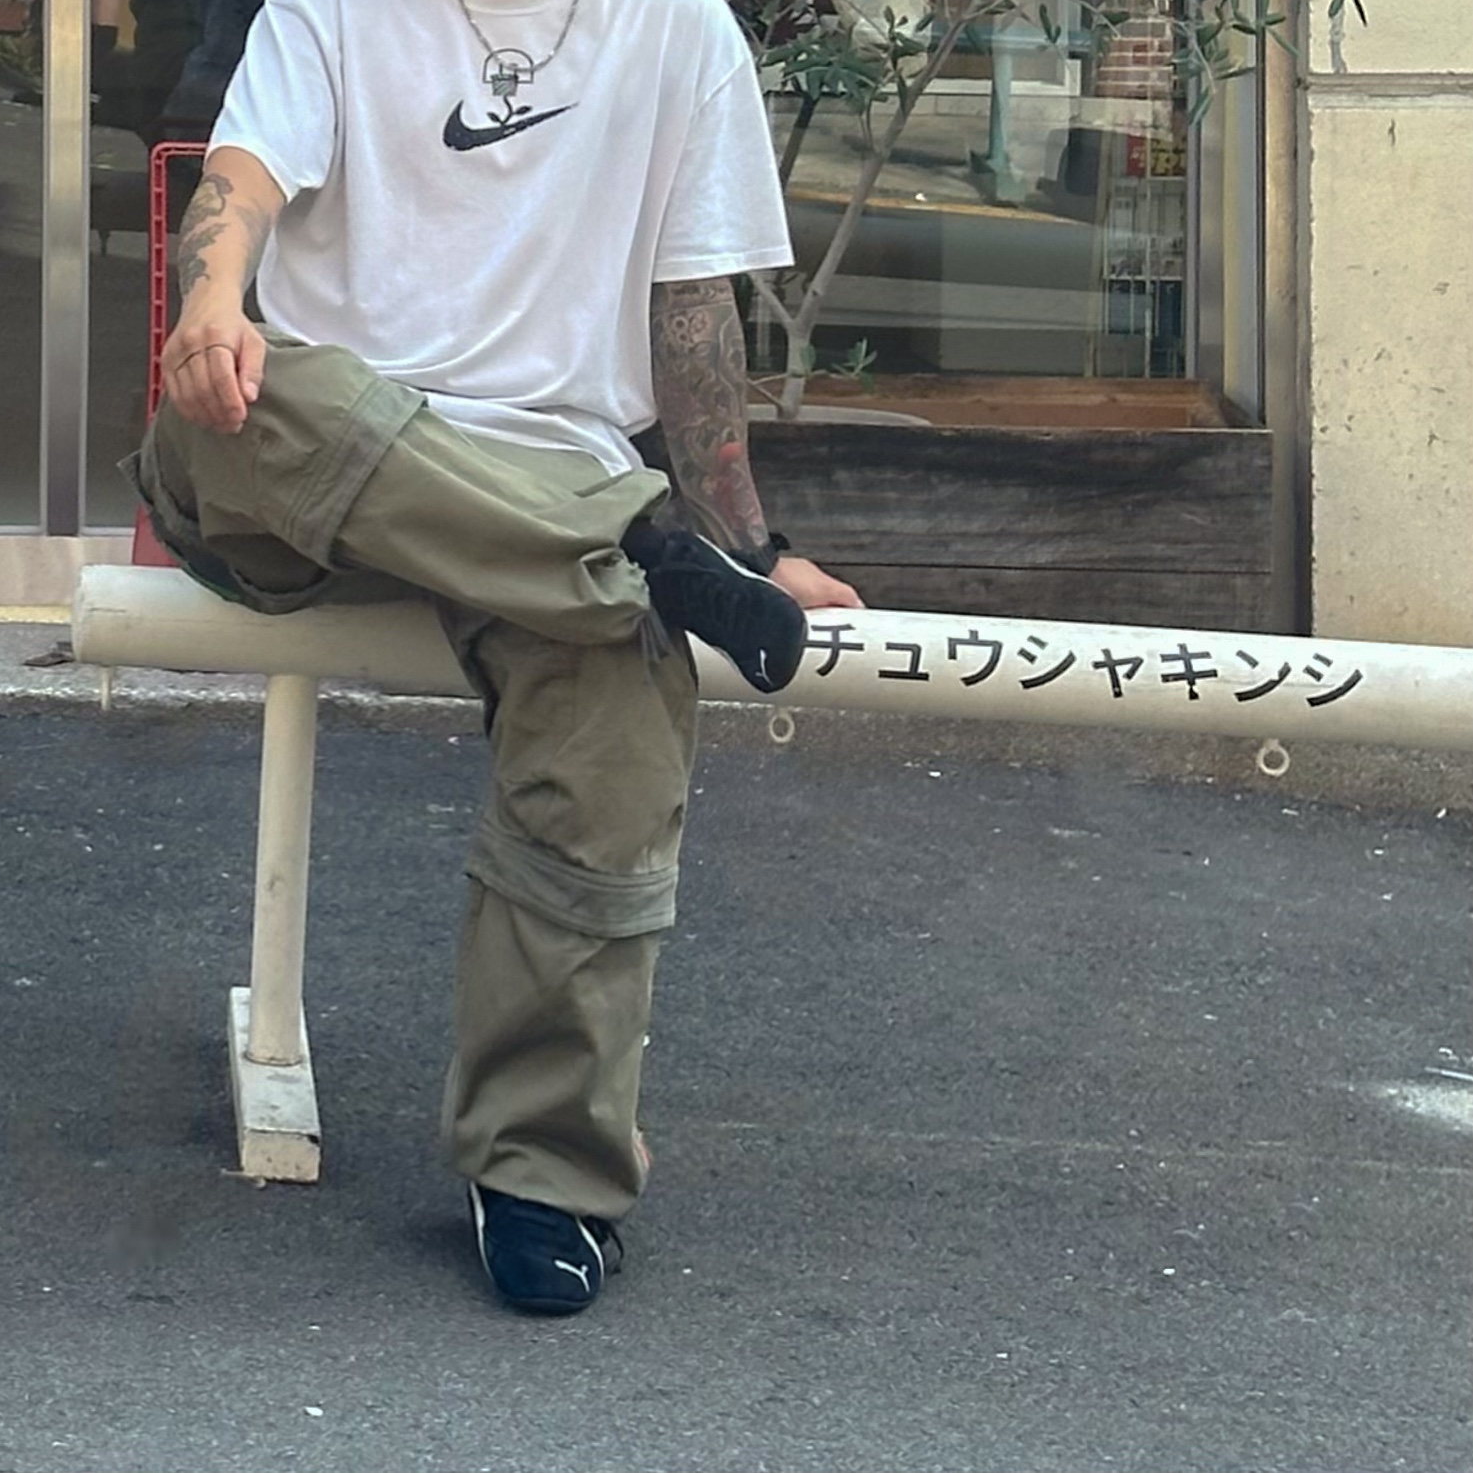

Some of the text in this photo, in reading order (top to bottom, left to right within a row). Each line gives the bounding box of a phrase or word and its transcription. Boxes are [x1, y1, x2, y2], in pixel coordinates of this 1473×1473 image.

[803, 623, 1364, 707] チュウシャキンシ
